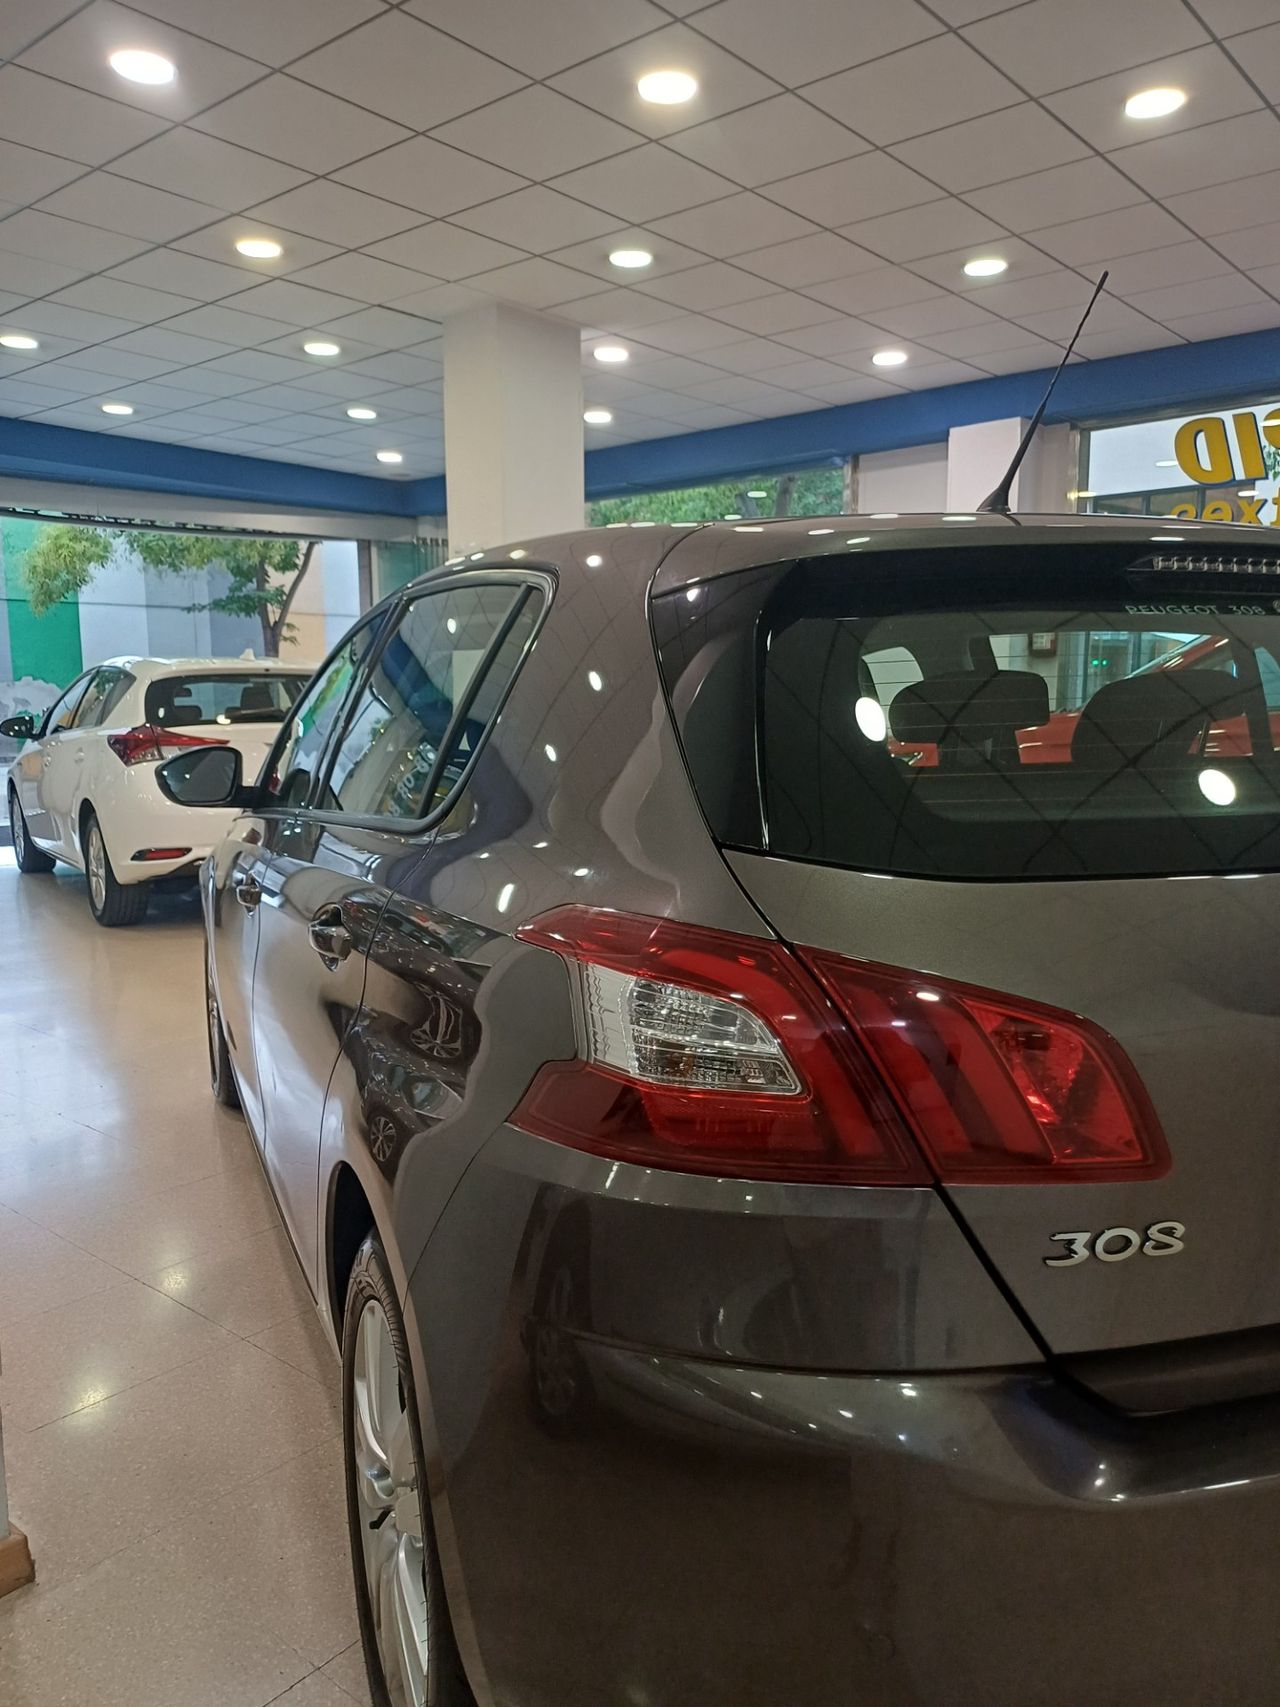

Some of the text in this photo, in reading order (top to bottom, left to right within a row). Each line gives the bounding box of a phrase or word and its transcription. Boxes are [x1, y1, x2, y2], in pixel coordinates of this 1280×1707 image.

[1124, 604, 1220, 615] PEUGEOT
[1227, 604, 1266, 616] 308
[1044, 1220, 1187, 1268] 308
